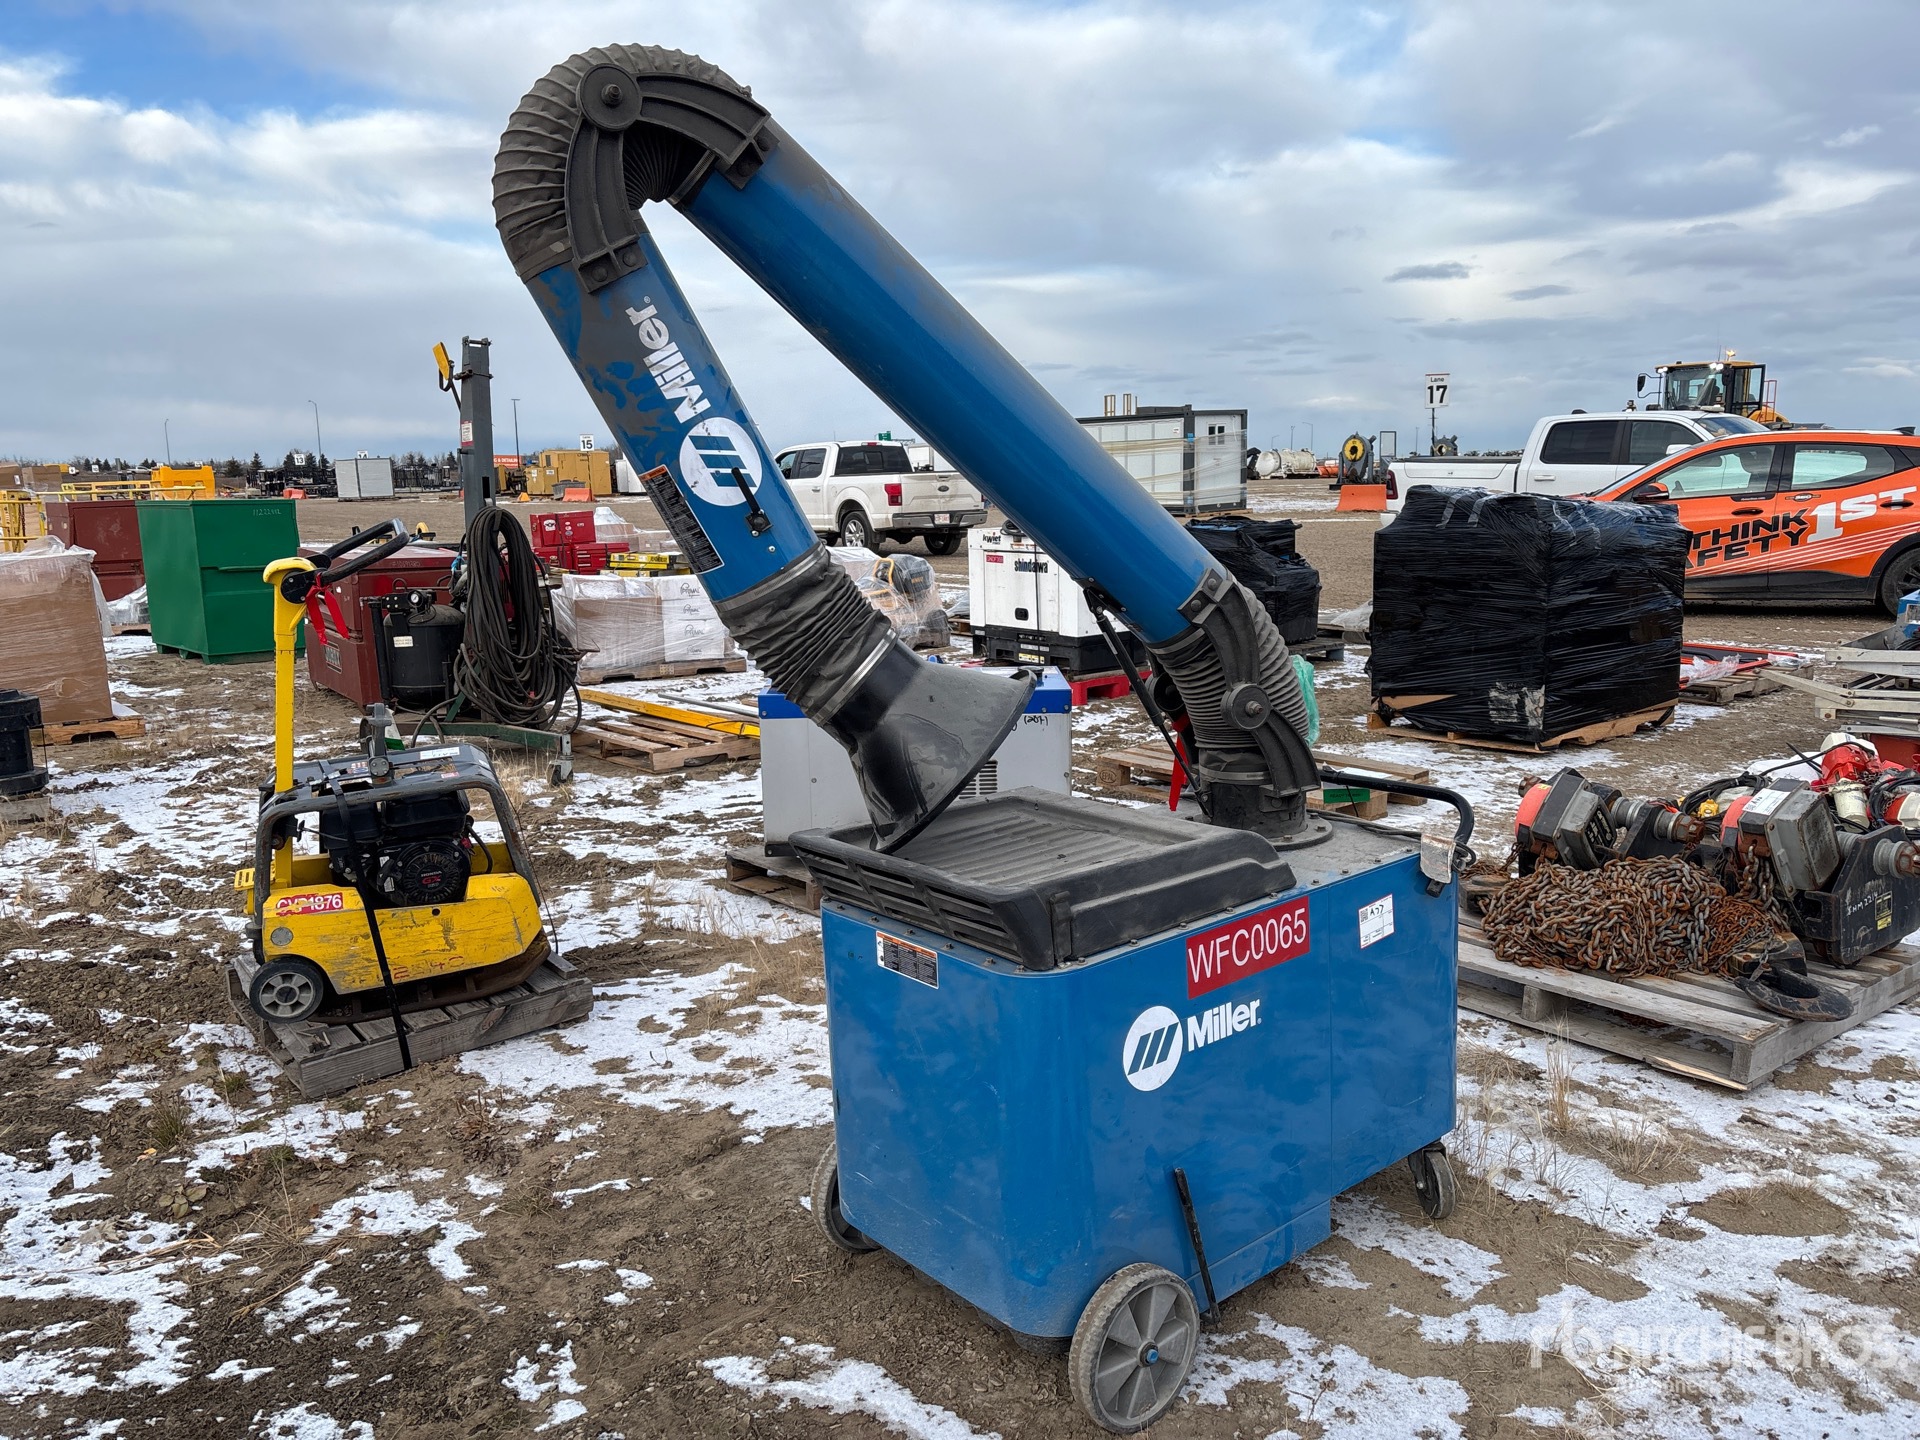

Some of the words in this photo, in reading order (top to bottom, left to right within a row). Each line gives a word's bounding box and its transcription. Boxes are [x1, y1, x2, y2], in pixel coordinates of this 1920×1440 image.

[625, 302, 711, 423] Miller
[1427, 384, 1448, 404] 17
[581, 440, 593, 450] 15
[1692, 508, 1811, 550] THINK
[1807, 486, 1917, 543] 1ST
[421, 875, 442, 884] GX
[1187, 905, 1308, 987] WFC0065
[1187, 998, 1260, 1051] Miller
